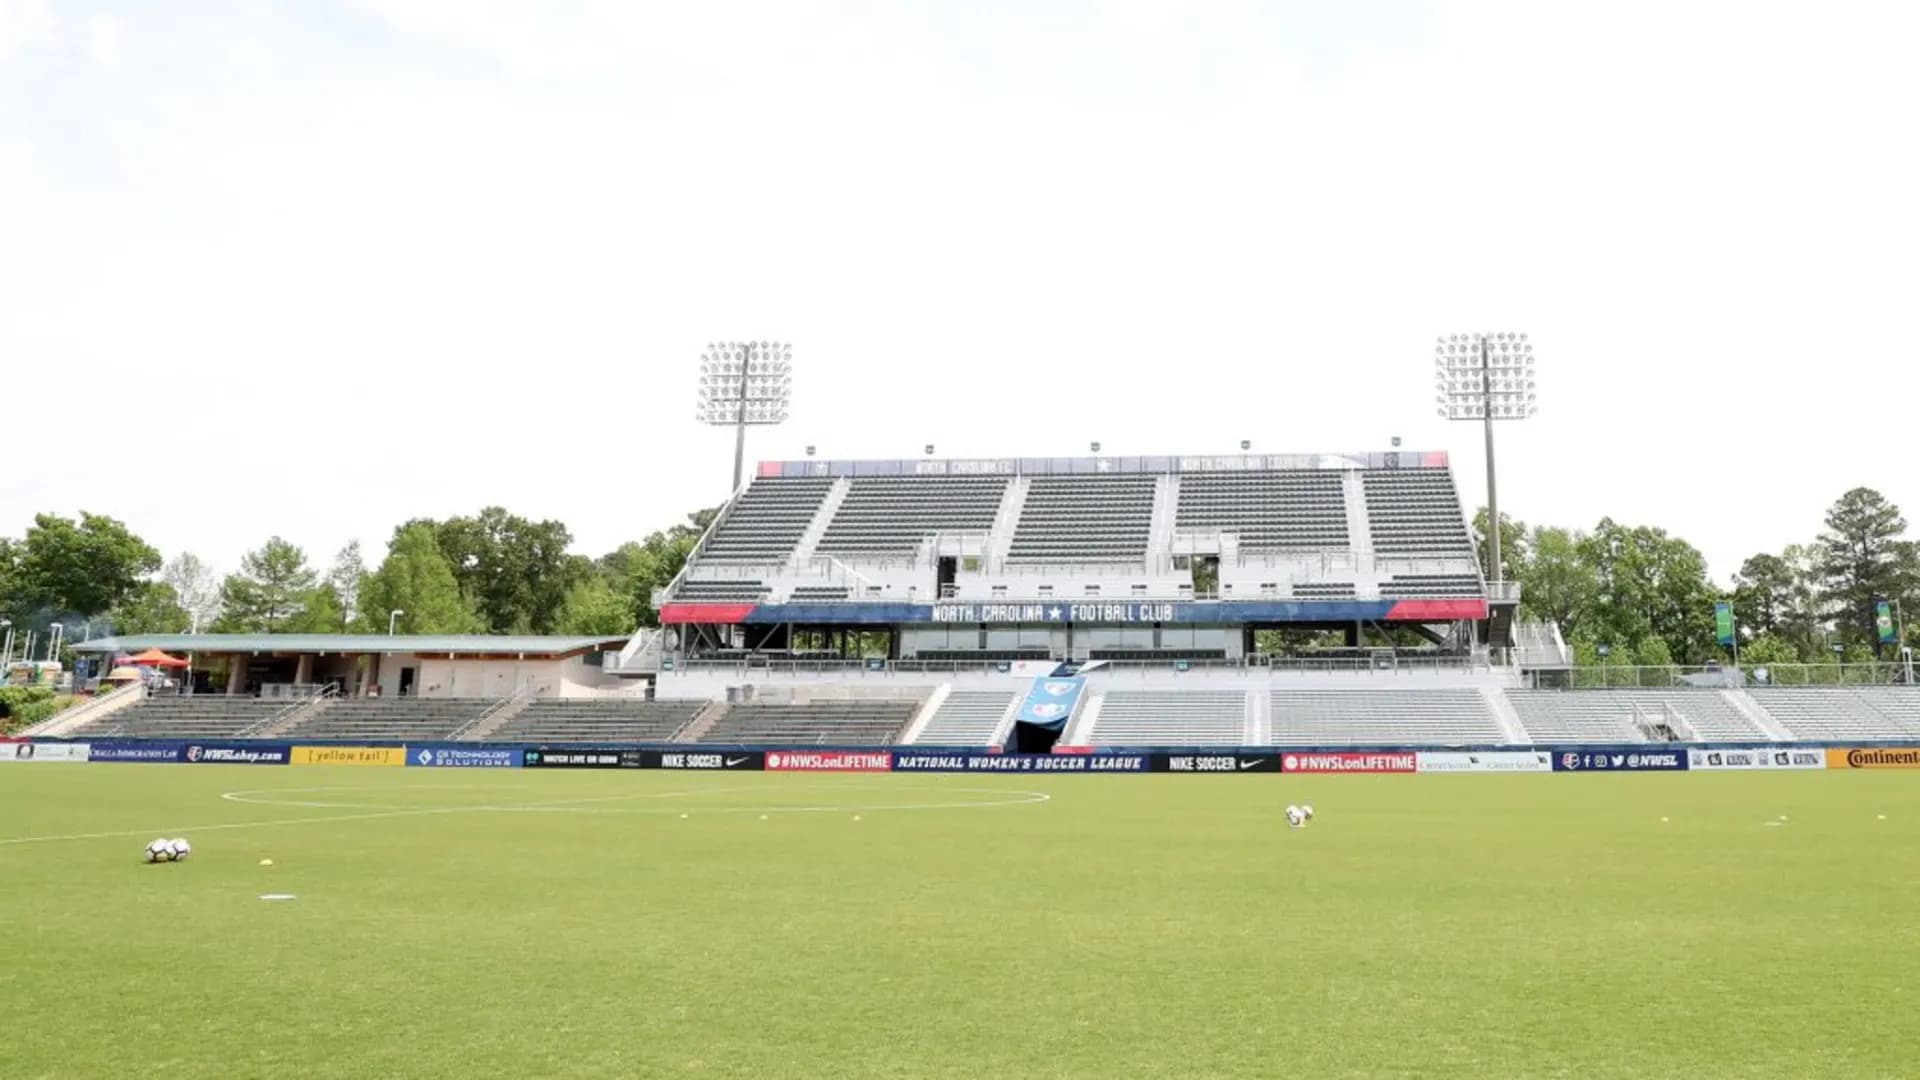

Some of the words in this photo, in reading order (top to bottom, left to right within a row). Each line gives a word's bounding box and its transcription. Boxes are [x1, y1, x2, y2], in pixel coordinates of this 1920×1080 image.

[933, 604, 975, 621] NORTH
[982, 604, 1043, 621] CAROLINA
[1070, 604, 1135, 621] FOOTBALL
[1140, 604, 1173, 621] CLUB
[317, 749, 355, 761] yellow
[662, 754, 685, 767] NIKE
[686, 755, 722, 768] SOCCER
[782, 755, 890, 768] #NWSLonLIFETIME
[1627, 754, 1678, 768] @NWSL
[897, 756, 964, 769] NATIONAL
[968, 757, 1031, 769] WOMEN'S
[1035, 757, 1085, 769] SOCCER
[1090, 757, 1142, 769] LEAGUE
[1169, 757, 1195, 770] NIKE
[1195, 757, 1236, 771] SOCCER
[1300, 756, 1415, 770] #NWSLonLIFETIME
